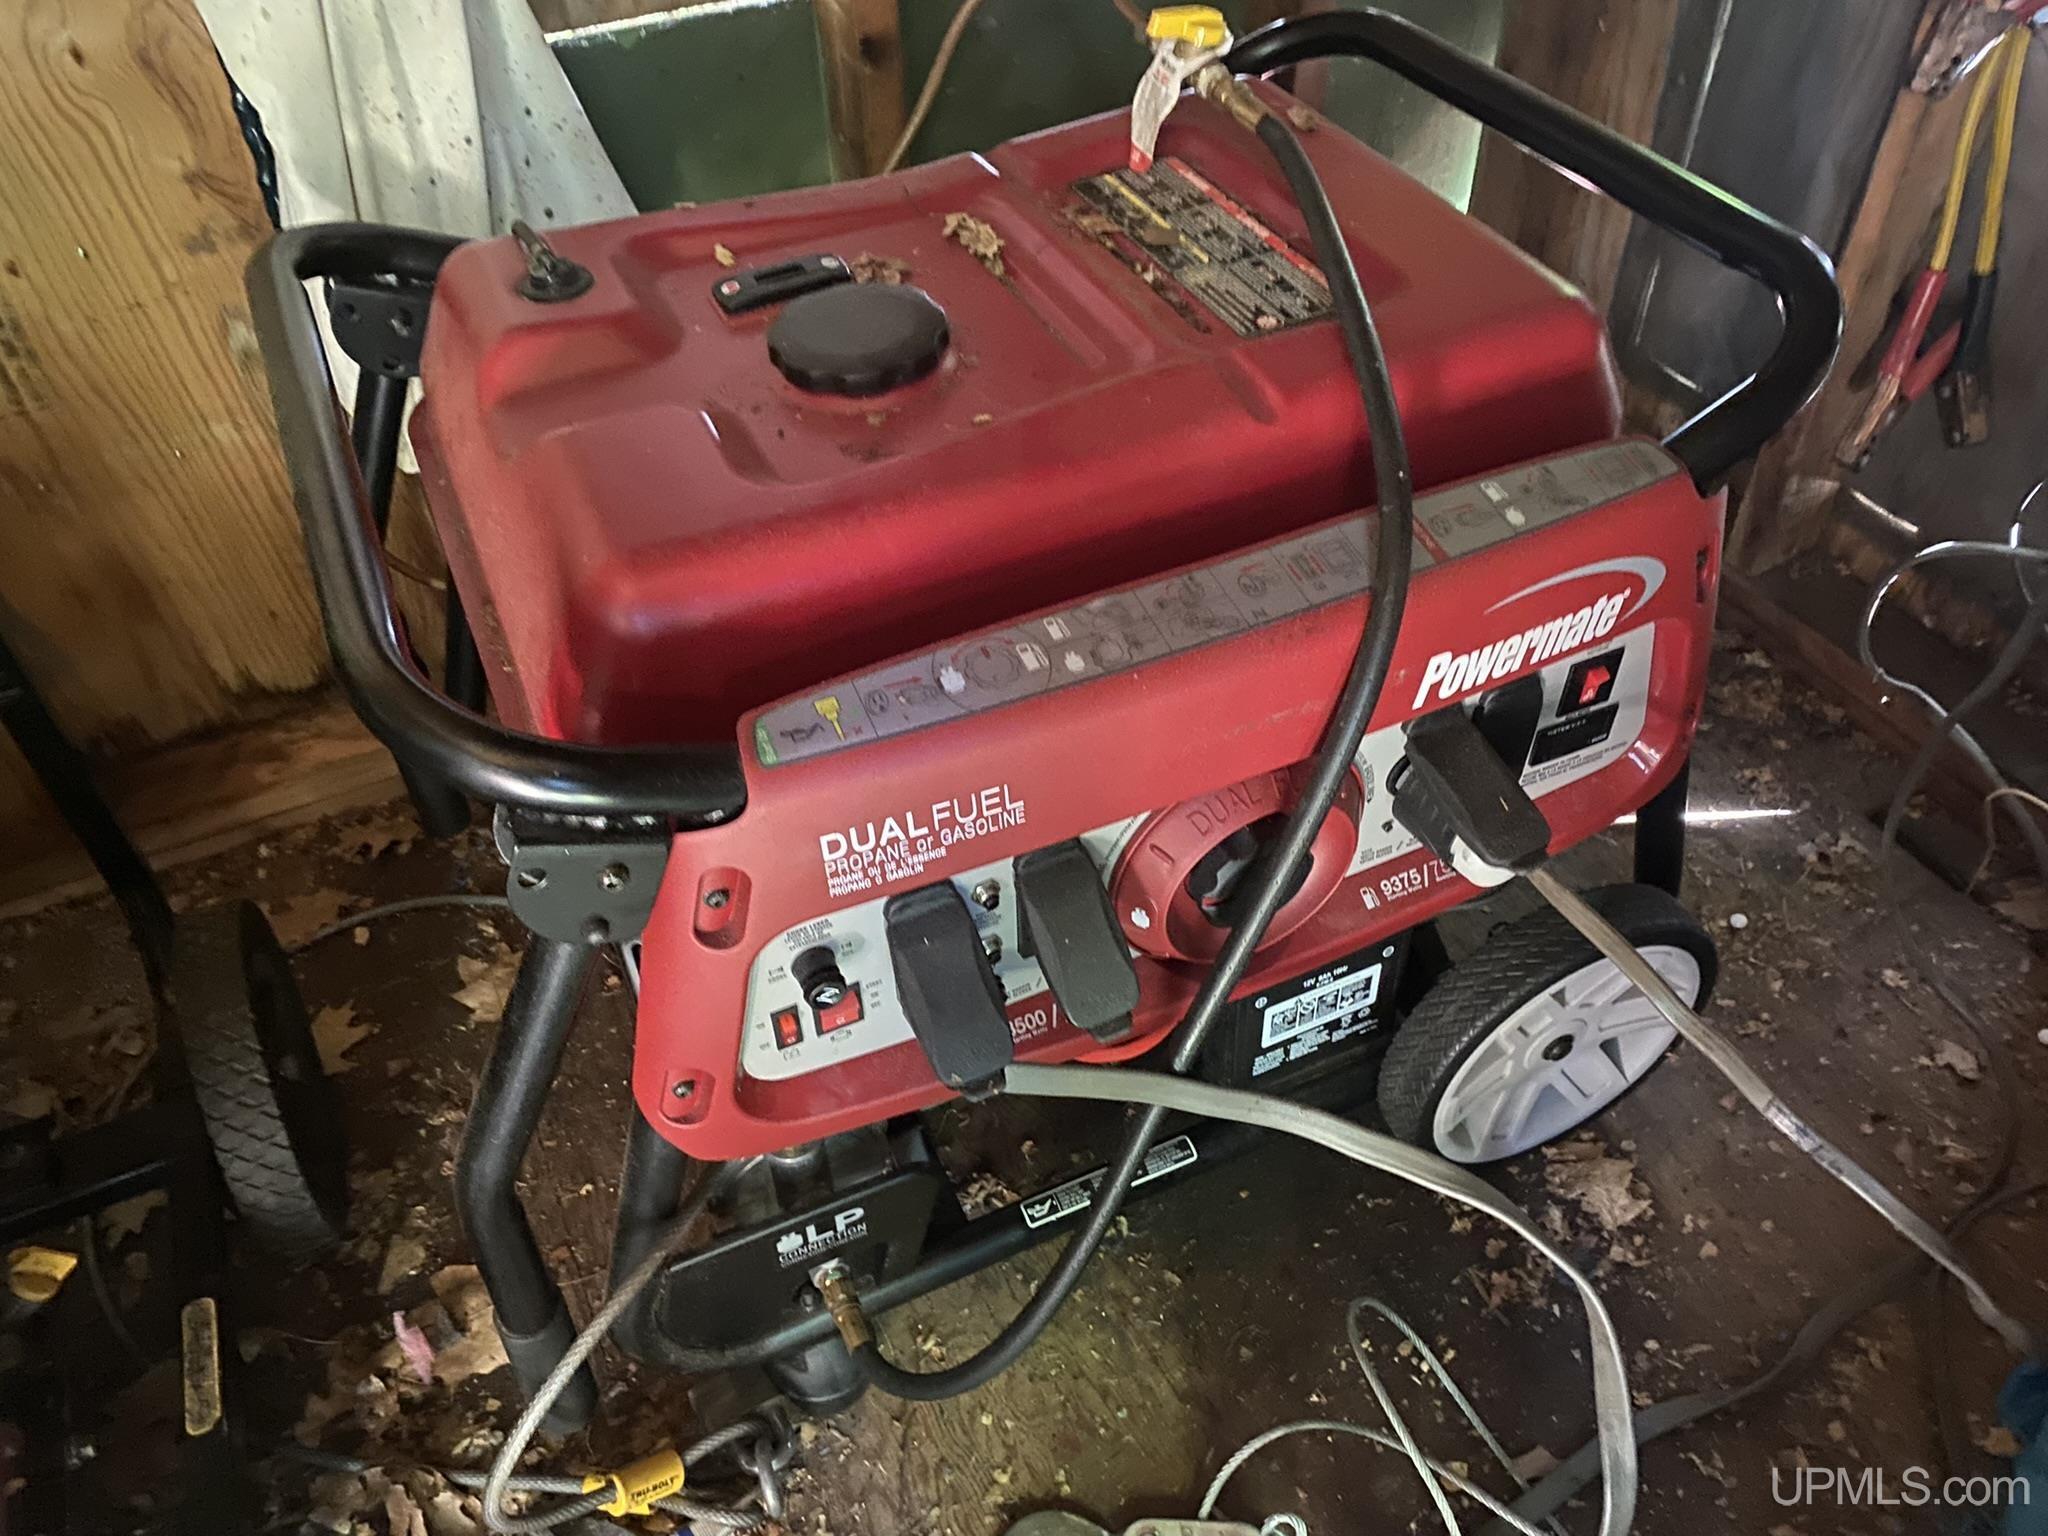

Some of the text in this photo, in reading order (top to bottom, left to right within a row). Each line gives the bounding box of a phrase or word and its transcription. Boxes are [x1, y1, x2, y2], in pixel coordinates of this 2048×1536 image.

[1411, 592, 1624, 711] Powermate
[819, 783, 1025, 861] DUAL FUEL
[1185, 782, 1263, 837] DUAL
[824, 806, 1026, 878] PROPANE or GASOLINE
[1380, 867, 1422, 896] 9375
[805, 1207, 865, 1244] LP
